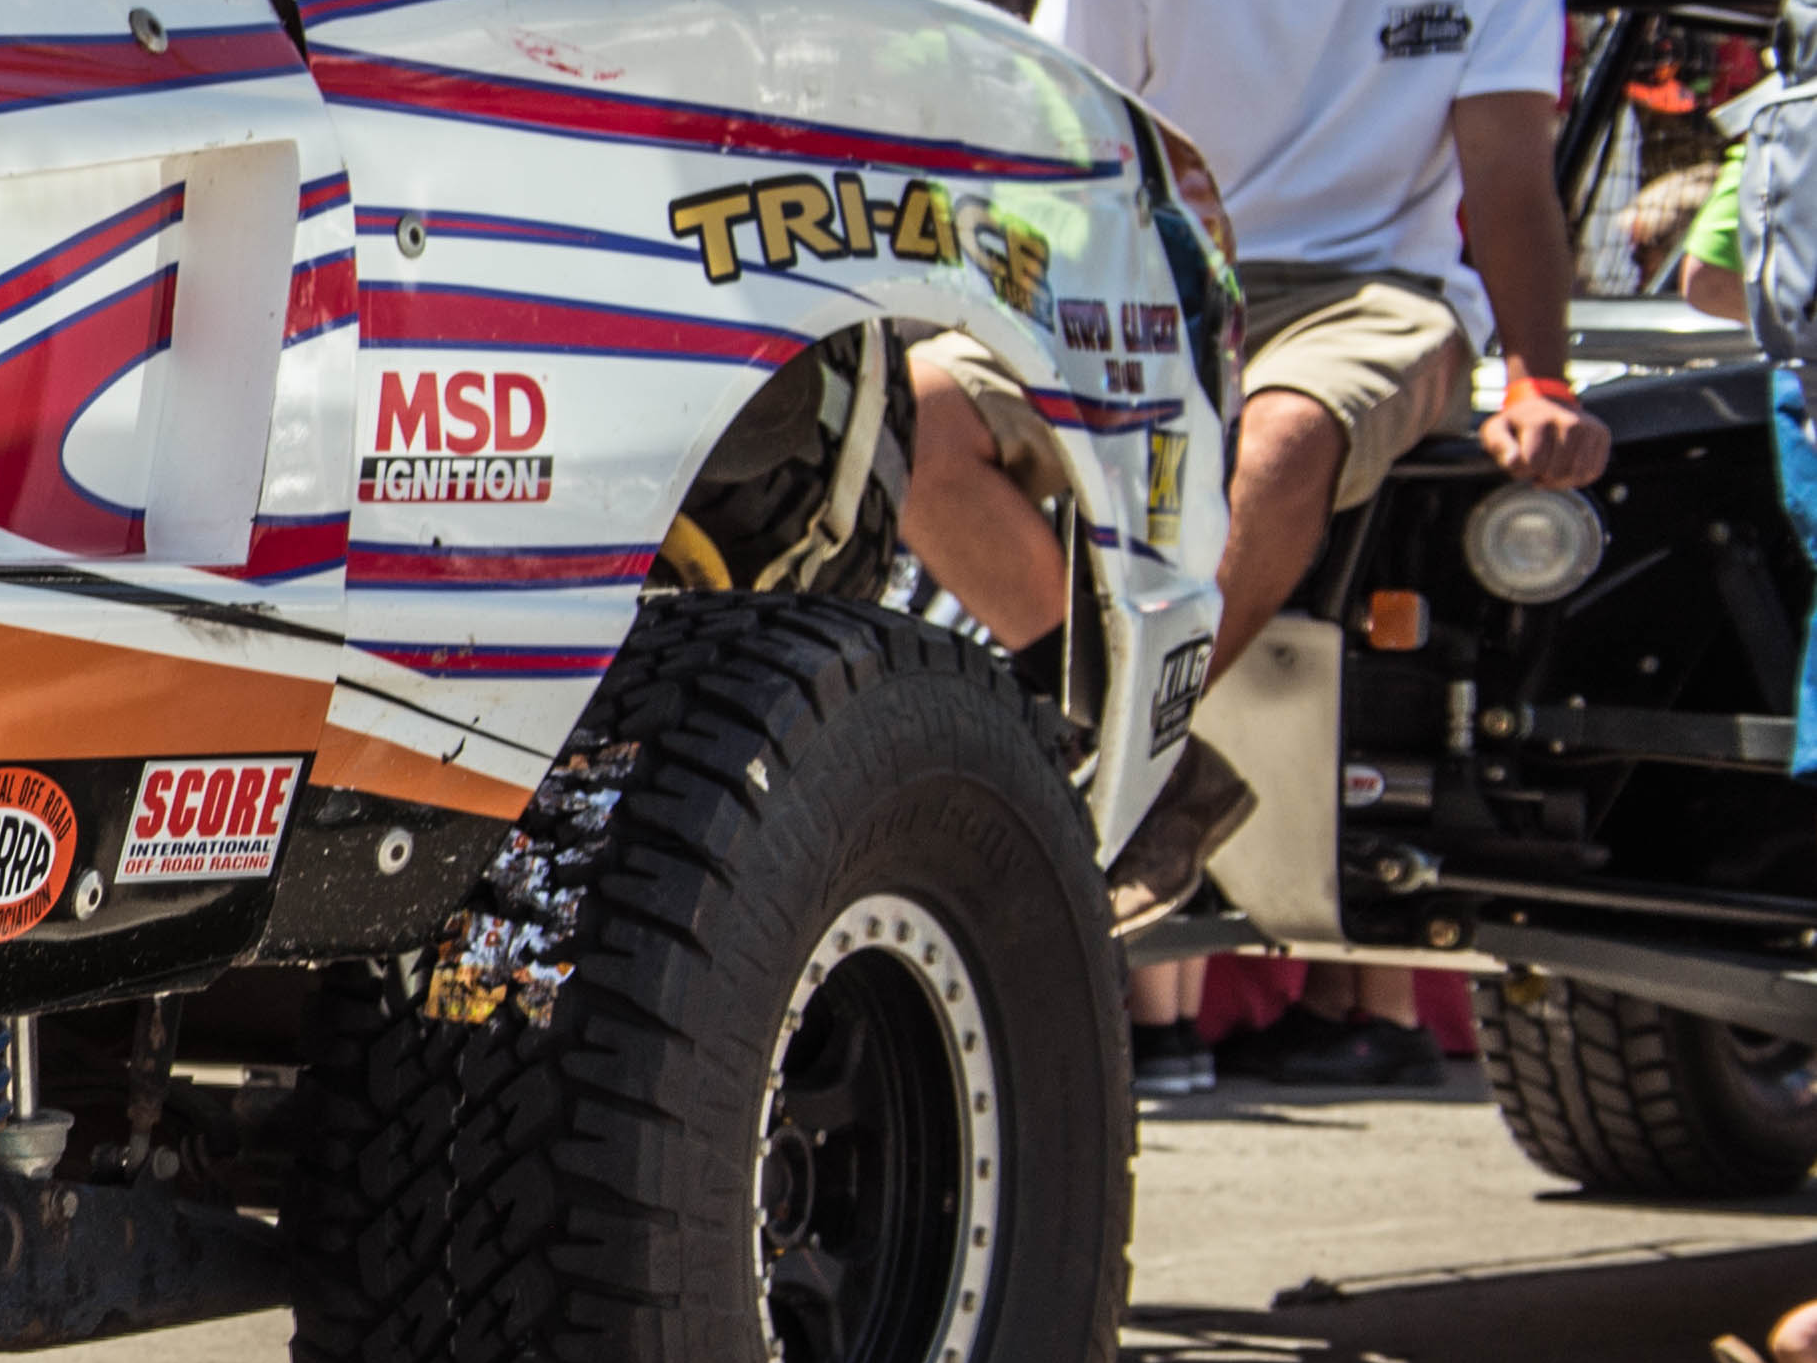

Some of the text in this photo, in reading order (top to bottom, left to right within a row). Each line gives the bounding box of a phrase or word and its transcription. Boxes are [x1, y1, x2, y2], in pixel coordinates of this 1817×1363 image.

[374, 370, 548, 456] MSD
[372, 457, 541, 502] IGNITION
[18, 774, 44, 805] OFF
[45, 793, 73, 841] ROAD
[134, 767, 294, 840] SCORE
[123, 854, 270, 876] OFF-ROAD RACING
[128, 839, 271, 858] INTERNATIONAL
